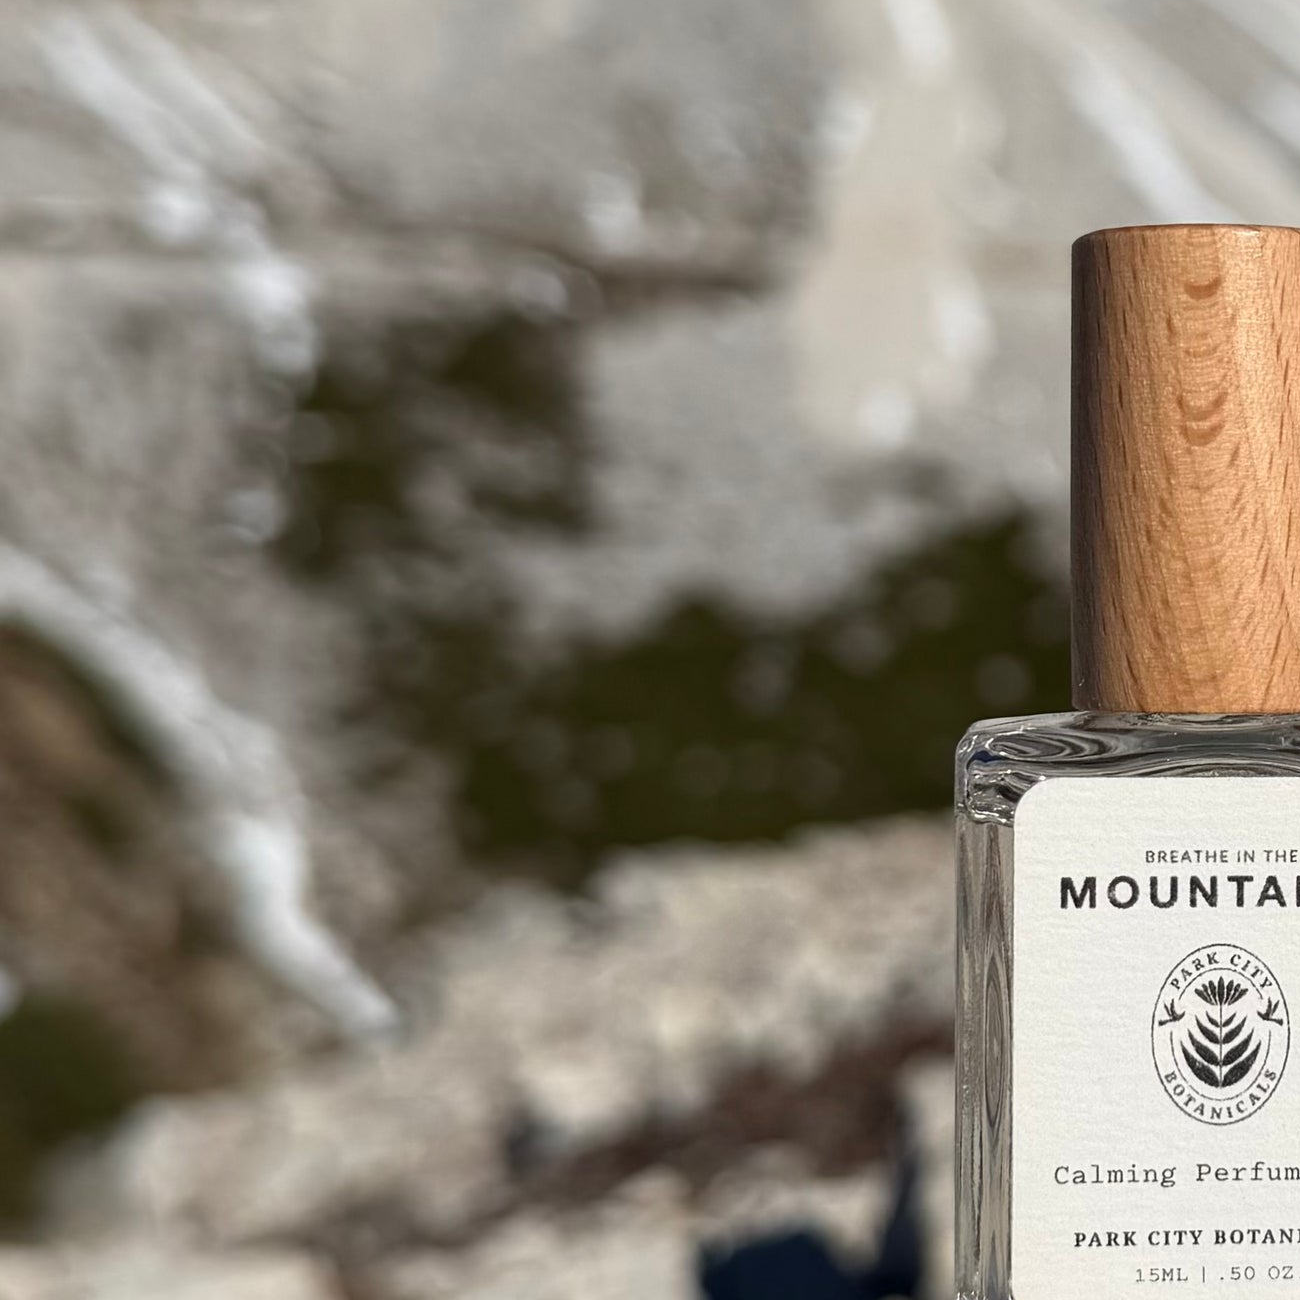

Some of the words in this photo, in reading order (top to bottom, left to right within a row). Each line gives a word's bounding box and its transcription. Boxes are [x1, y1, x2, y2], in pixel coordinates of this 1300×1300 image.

[1145, 849, 1229, 864] BREATHE
[1236, 849, 1256, 864] IN
[1263, 848, 1299, 864] THE
[1170, 951, 1220, 990] PARK
[1230, 953, 1273, 990] CITY
[1164, 1069, 1277, 1120] BOTANICALS
[1053, 1163, 1177, 1188] Calming
[1074, 1230, 1137, 1248] PARK
[1147, 1229, 1203, 1247] CITY
[1135, 1267, 1189, 1283] 15ML
[1219, 1266, 1256, 1281] .50
